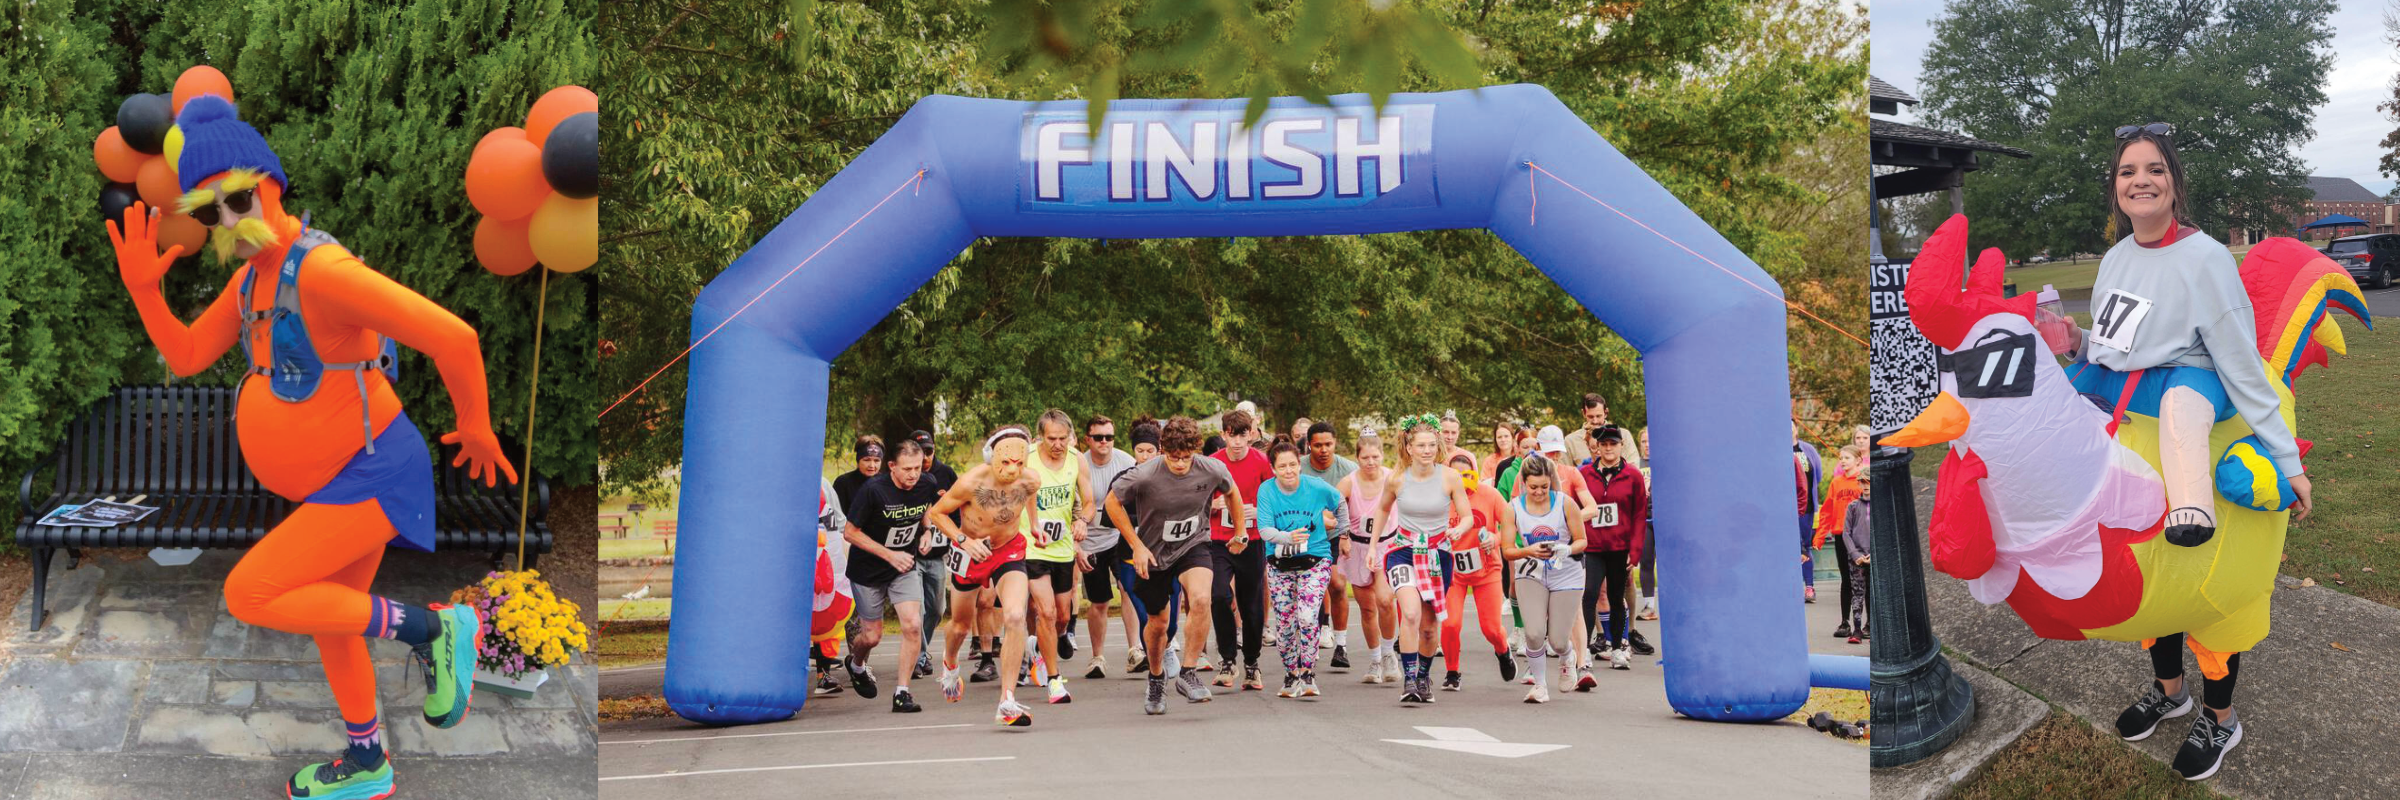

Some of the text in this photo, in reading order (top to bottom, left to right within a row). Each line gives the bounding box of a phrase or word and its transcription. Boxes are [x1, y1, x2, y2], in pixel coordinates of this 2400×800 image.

[1035, 112, 1404, 203] FINISH
[2097, 293, 2140, 340] 47
[882, 503, 928, 519] VICTORY
[1597, 505, 1613, 525] 78
[892, 527, 914, 545] 52
[1170, 520, 1192, 538] 44
[1454, 551, 1474, 572] 61
[1518, 556, 1538, 578] 72
[1391, 565, 1410, 587] 59
[444, 619, 452, 680] ALTRA
